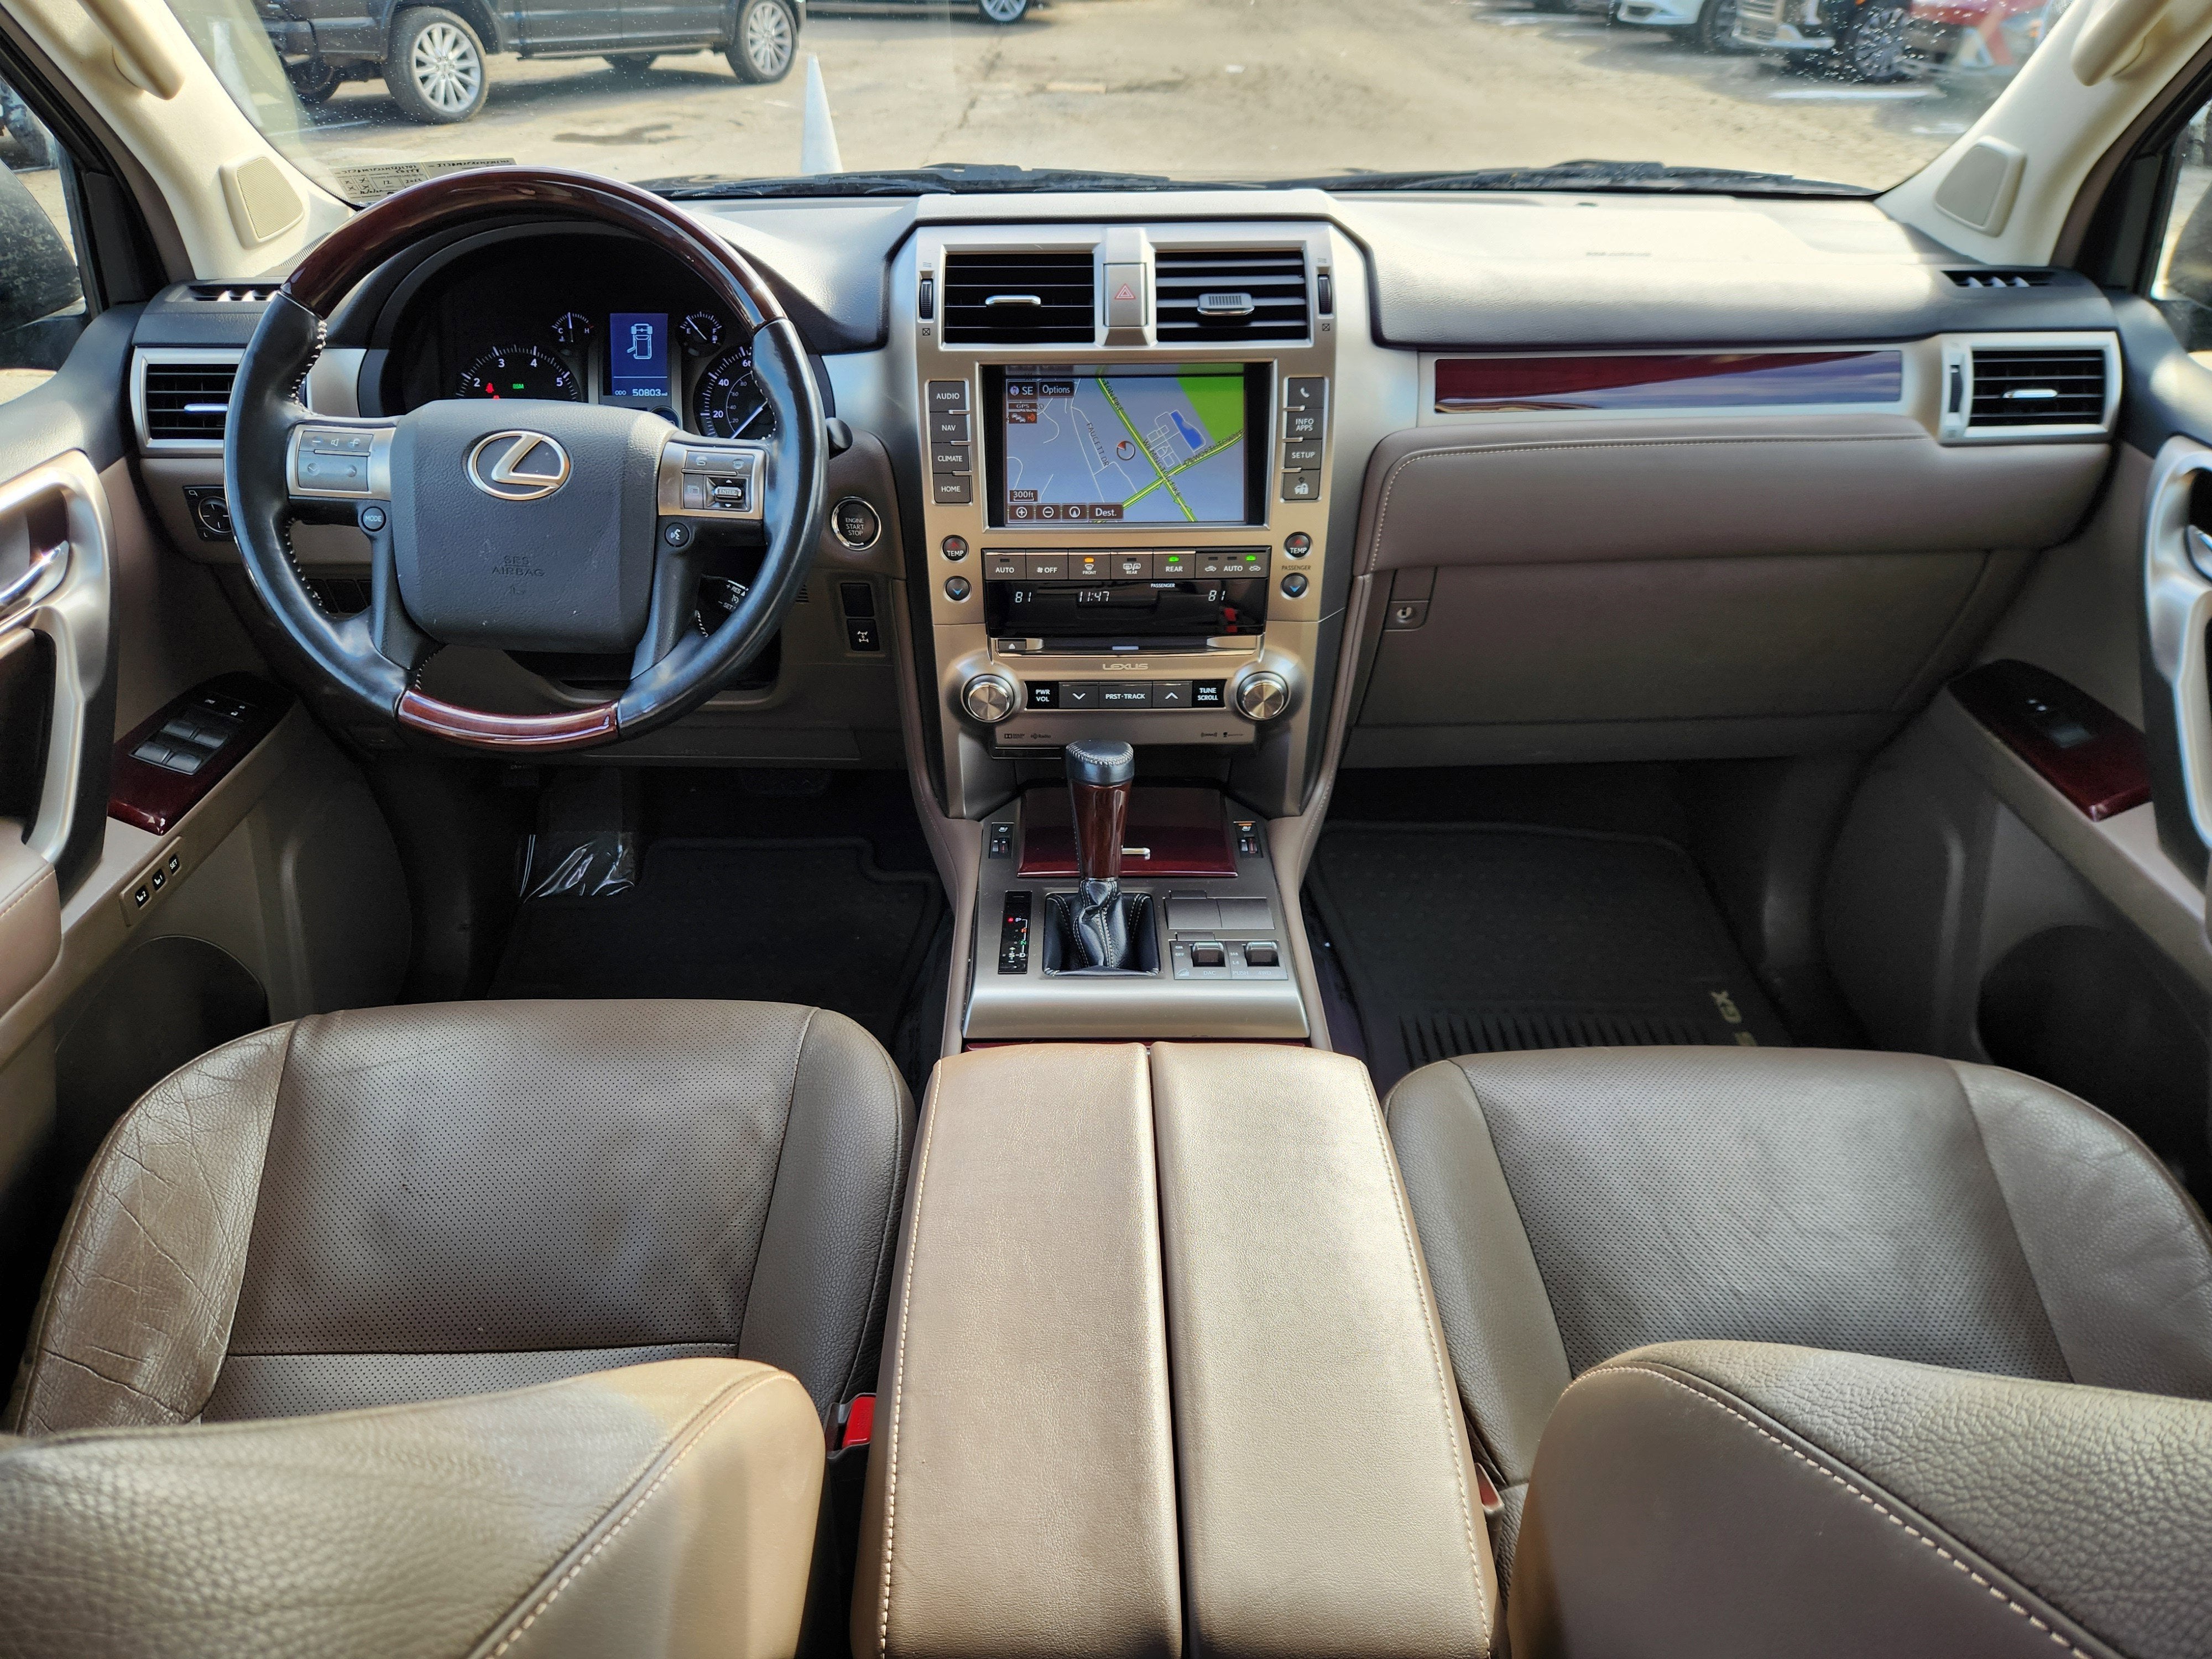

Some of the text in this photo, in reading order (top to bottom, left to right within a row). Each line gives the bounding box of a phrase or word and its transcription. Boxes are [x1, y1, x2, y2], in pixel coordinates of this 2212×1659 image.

[498, 358, 505, 367] 3
[530, 358, 537, 367] 4
[473, 378, 480, 387] 2
[556, 378, 563, 387] 5
[719, 378, 729, 387] 40
[1022, 387, 1034, 395] SE
[1042, 384, 1070, 395] Options
[1087, 422, 1109, 467] FAUCETT DR
[1095, 508, 1117, 516] Dest.
[492, 566, 545, 577] AIRBAG
[1078, 591, 1110, 603] 11:47
